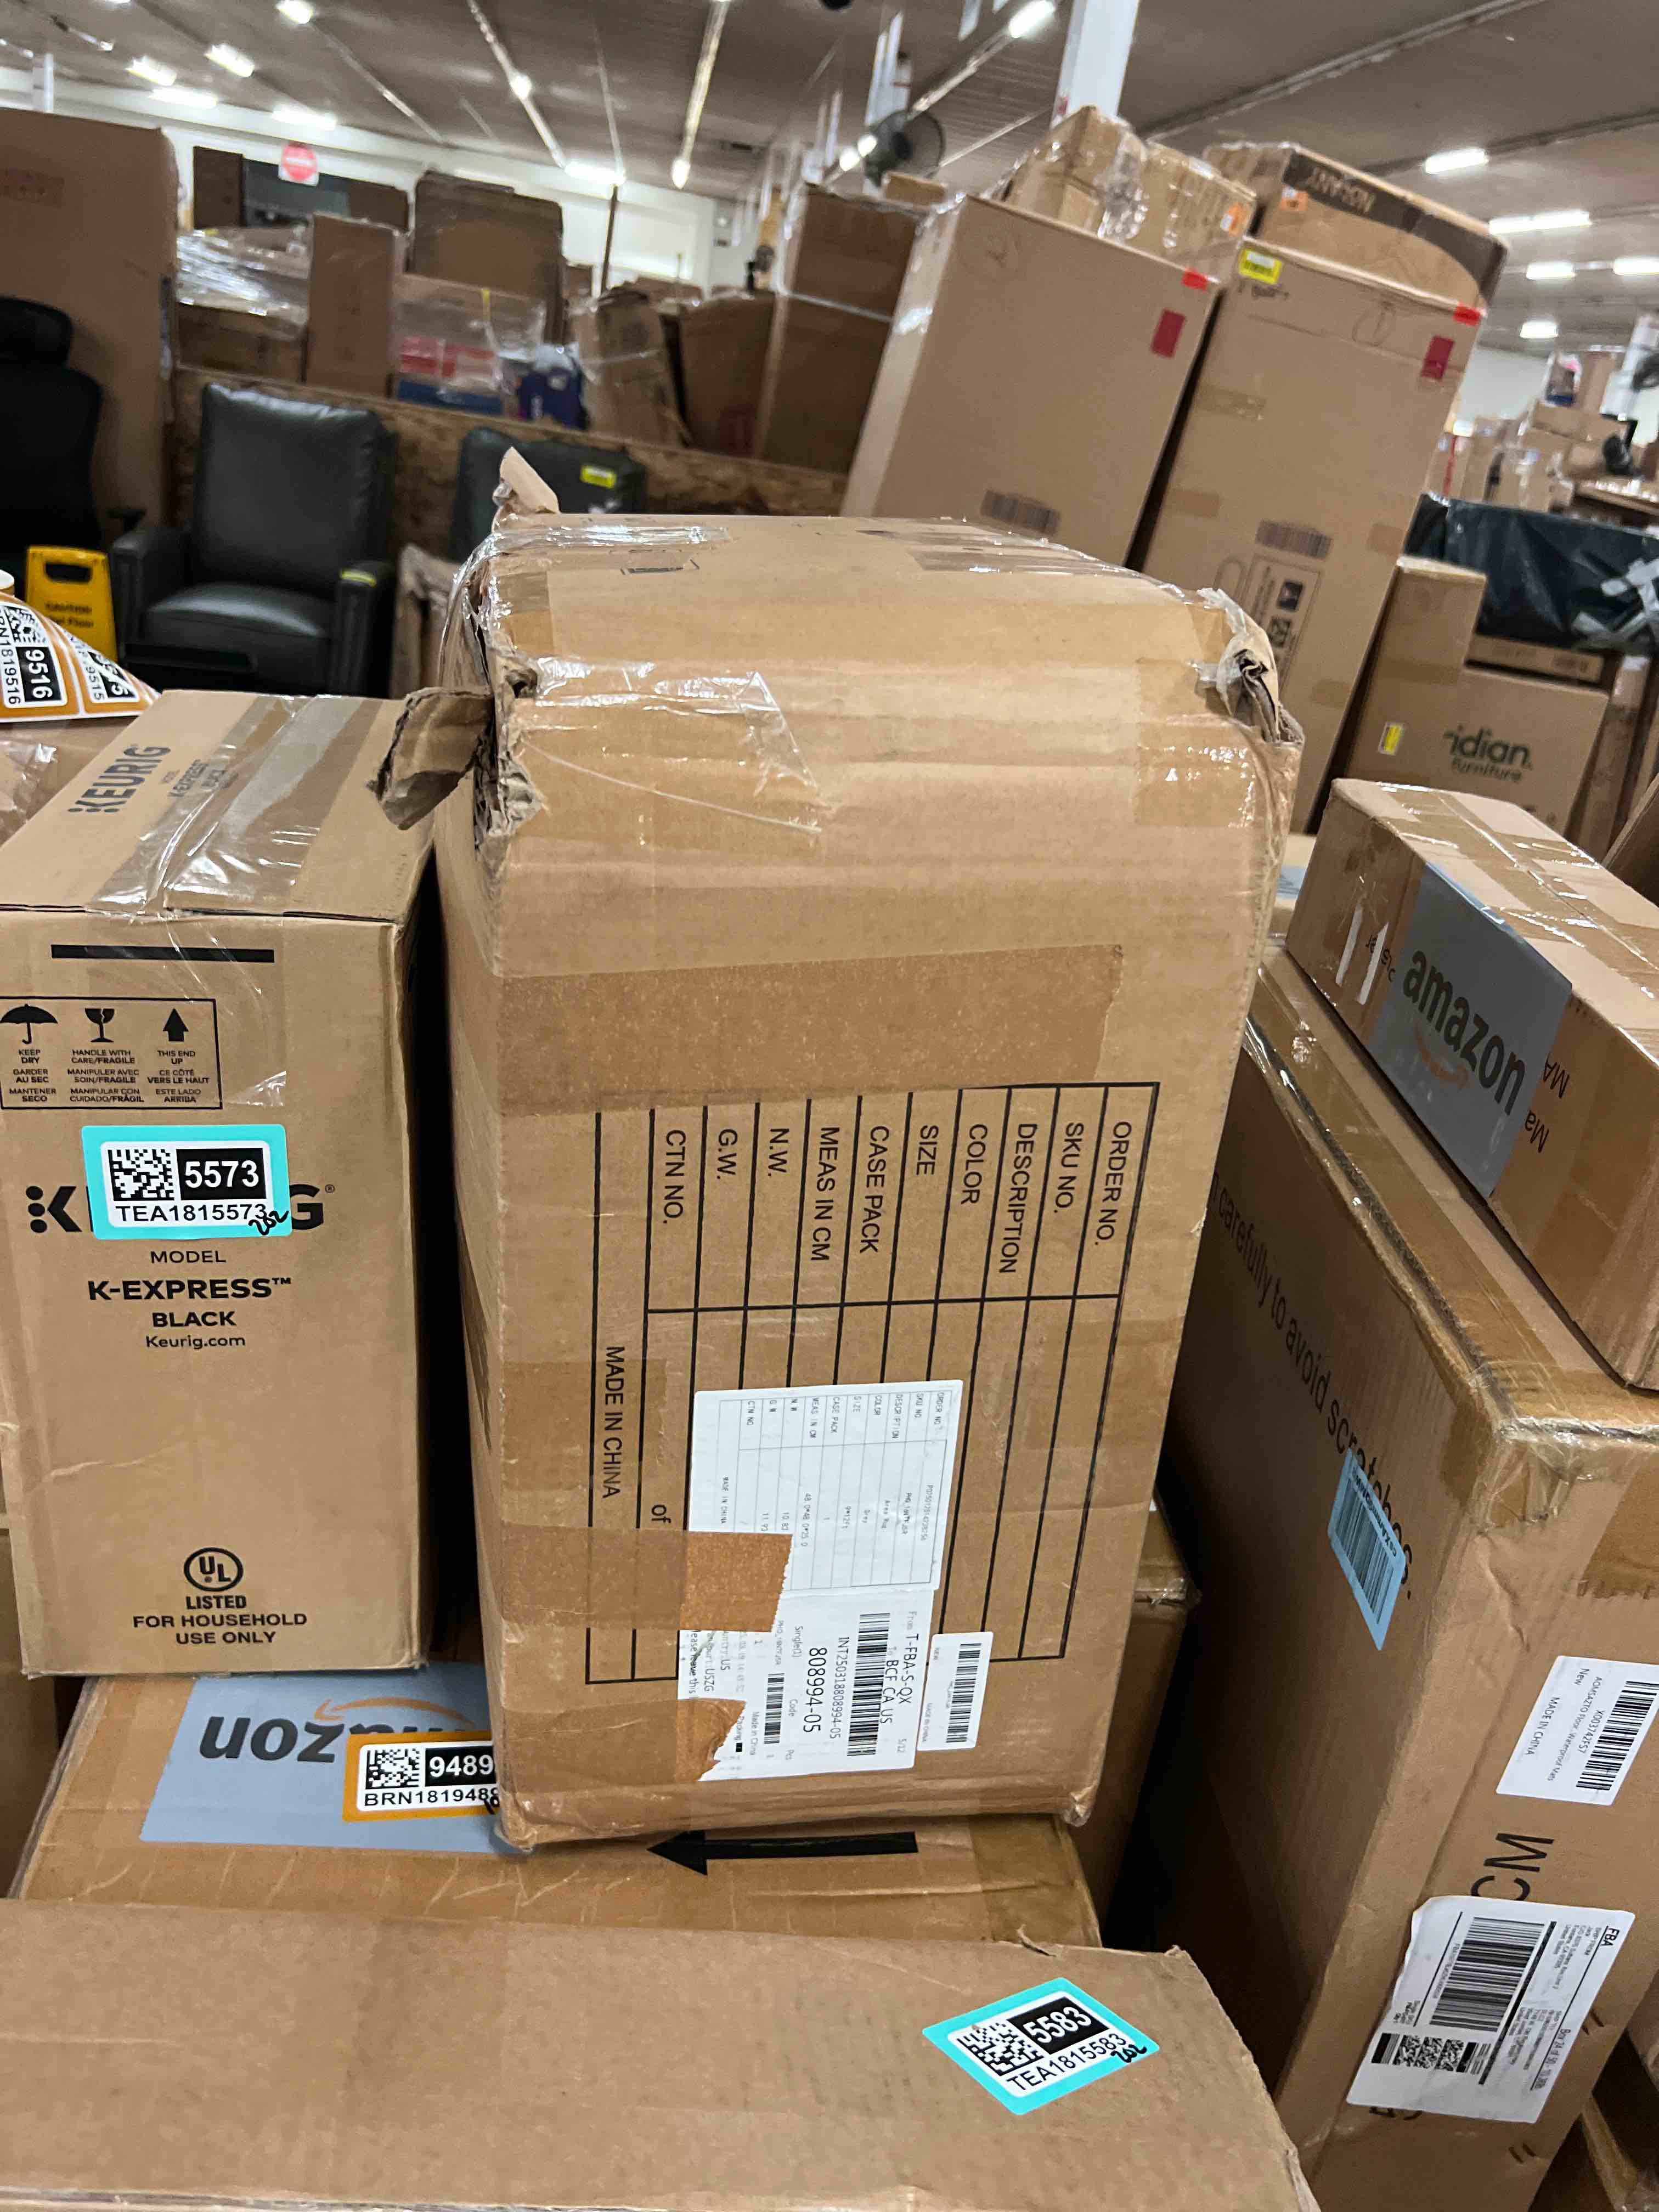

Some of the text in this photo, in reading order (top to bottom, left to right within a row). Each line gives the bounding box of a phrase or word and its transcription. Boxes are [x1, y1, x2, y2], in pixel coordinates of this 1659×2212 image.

[0, 609, 21, 704] RN1819516
[25, 650, 53, 698] 9516
[67, 747, 171, 812] KEURIG
[1402, 950, 1525, 1116] amazon
[716, 1128, 738, 1179] G.W.
[768, 1128, 789, 1177] N.W.
[916, 1125, 939, 1176] SIZE
[961, 1124, 988, 1205] COLOR
[184, 1161, 259, 1188] 5573
[663, 1130, 686, 1224] CTN NO.
[1054, 1122, 1085, 1213] SKU NO.
[1094, 1121, 1132, 1245] ORDER NO.
[811, 1127, 840, 1260] MEAS IN CM
[860, 1126, 889, 1253] CASE PACK
[999, 1124, 1038, 1273] DESCRIPTION
[116, 1204, 266, 1222] TEA1815573
[150, 1251, 227, 1263] MODEL
[1219, 1187, 1272, 1308] carefully
[1272, 1278, 1286, 1329] to
[1286, 1319, 1330, 1413] avoid
[152, 1311, 236, 1327] BLACK
[145, 1336, 245, 1349] Keurig.com
[811, 1398, 819, 1414] MEAS
[853, 1396, 861, 1413] SIZE
[873, 1395, 882, 1415] COLOR
[916, 1393, 924, 1406] SKU
[935, 1392, 944, 1413] ORDER
[602, 1347, 624, 1498] MADE IN CHINA
[892, 1394, 903, 1438] DESCRIPTION
[810, 1430, 816, 1438] CM
[651, 1504, 671, 1523] of
[186, 1595, 246, 1609] LISTED
[133, 1613, 307, 1628] FOR HOUSEHOLD
[176, 1632, 276, 1644] USE ONLY
[885, 1660, 899, 1681] BCF
[896, 1634, 918, 1704] T-FBA-S-QX
[1575, 1668, 1589, 1685] New
[803, 1647, 827, 1733] 808994-05
[883, 1688, 895, 1703] CA
[788, 1699, 798, 1717] Code
[881, 1709, 893, 1723] US
[1526, 1697, 1560, 1755] MADE IN CHINA
[430, 1755, 493, 1777] 9489
[1600, 1928, 1621, 1947] FBA
[1023, 2007, 1091, 2044] 5583
[1007, 2033, 1126, 2090] TEA1815583
